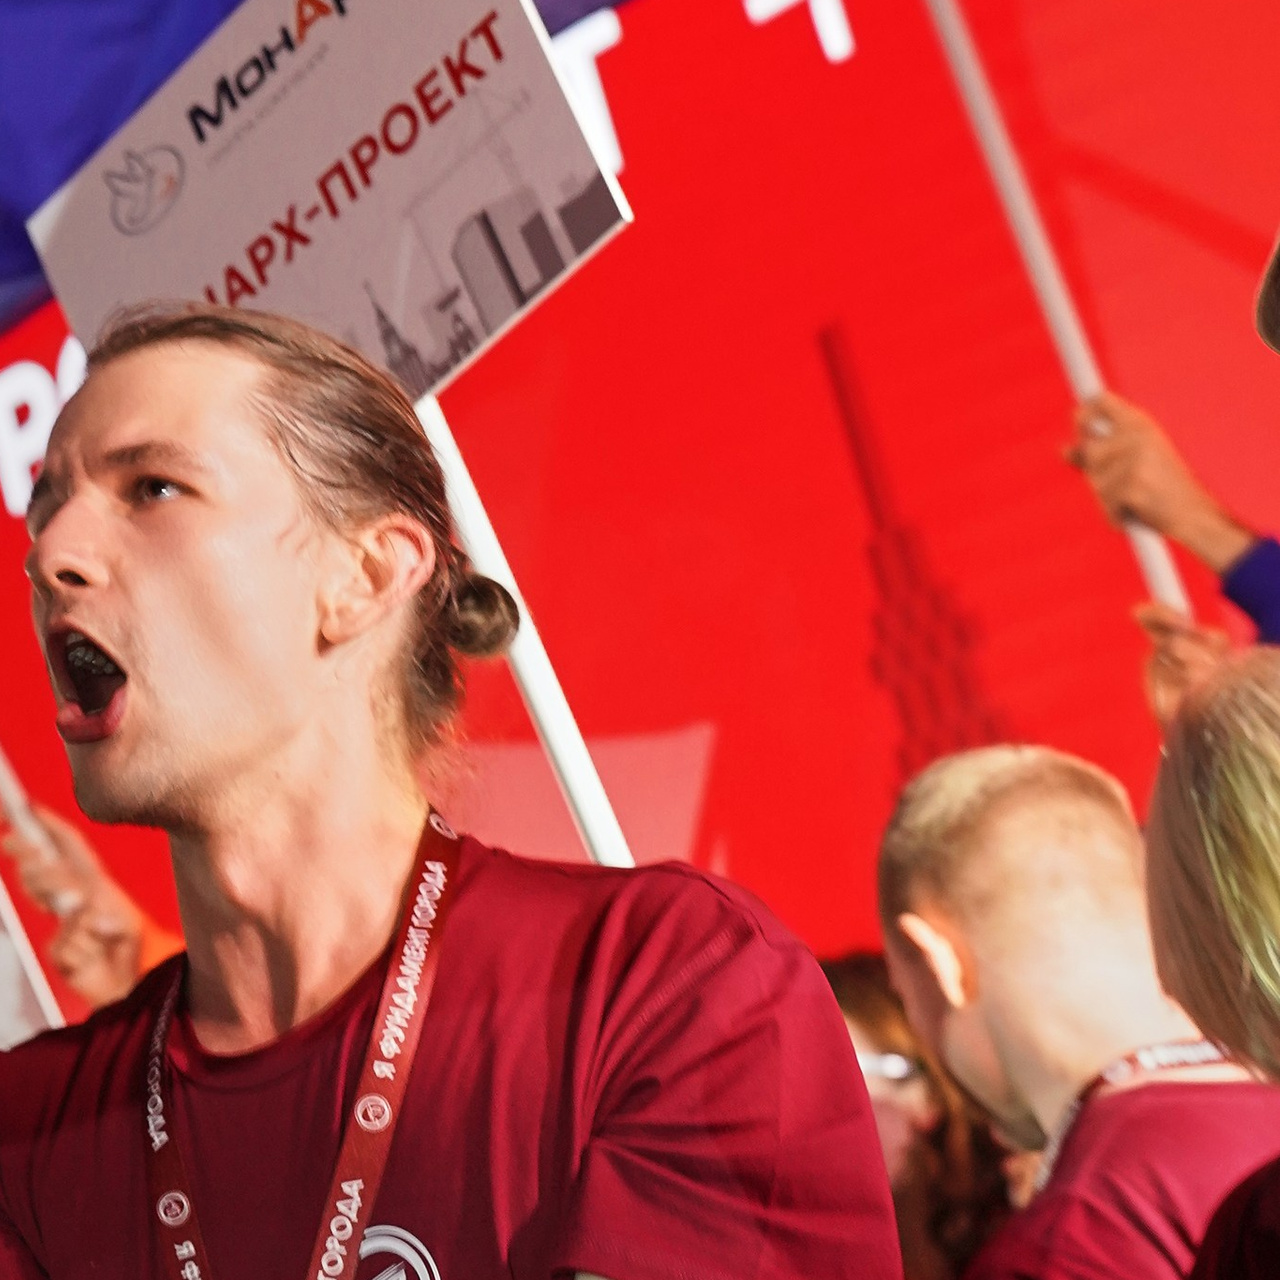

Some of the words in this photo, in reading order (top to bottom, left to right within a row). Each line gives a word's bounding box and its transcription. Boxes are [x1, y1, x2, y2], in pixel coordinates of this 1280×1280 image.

[202, 7, 507, 308] АРХ-ПРОЕКТ
[372, 1058, 397, 1082] Я
[410, 859, 448, 929] ГОРОДА
[173, 1239, 197, 1261] Я
